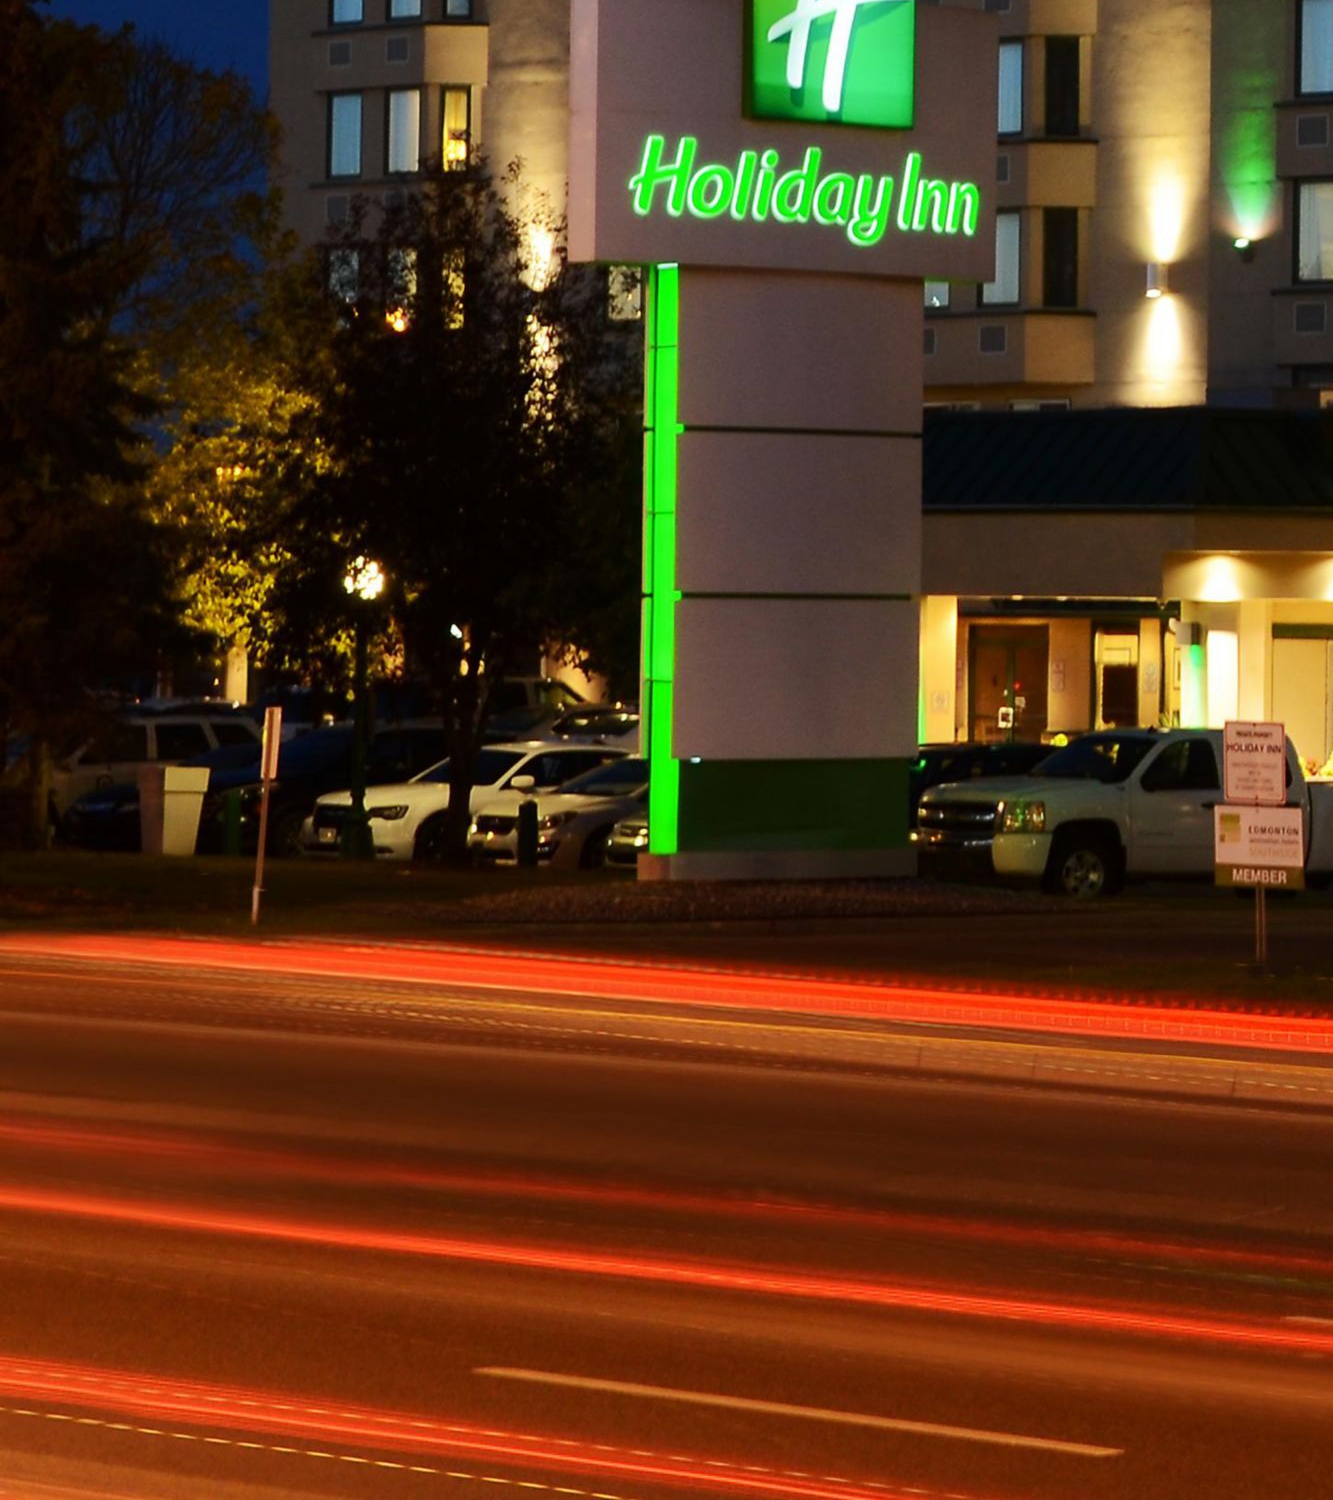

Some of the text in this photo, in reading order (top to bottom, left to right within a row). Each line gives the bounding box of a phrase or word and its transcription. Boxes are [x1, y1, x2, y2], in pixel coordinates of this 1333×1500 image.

[628, 134, 980, 246] Holiday Inn
[1226, 743, 1265, 753] HOLIDAY
[1248, 825, 1299, 836] EDMONTON
[1232, 868, 1288, 884] MEMBER
